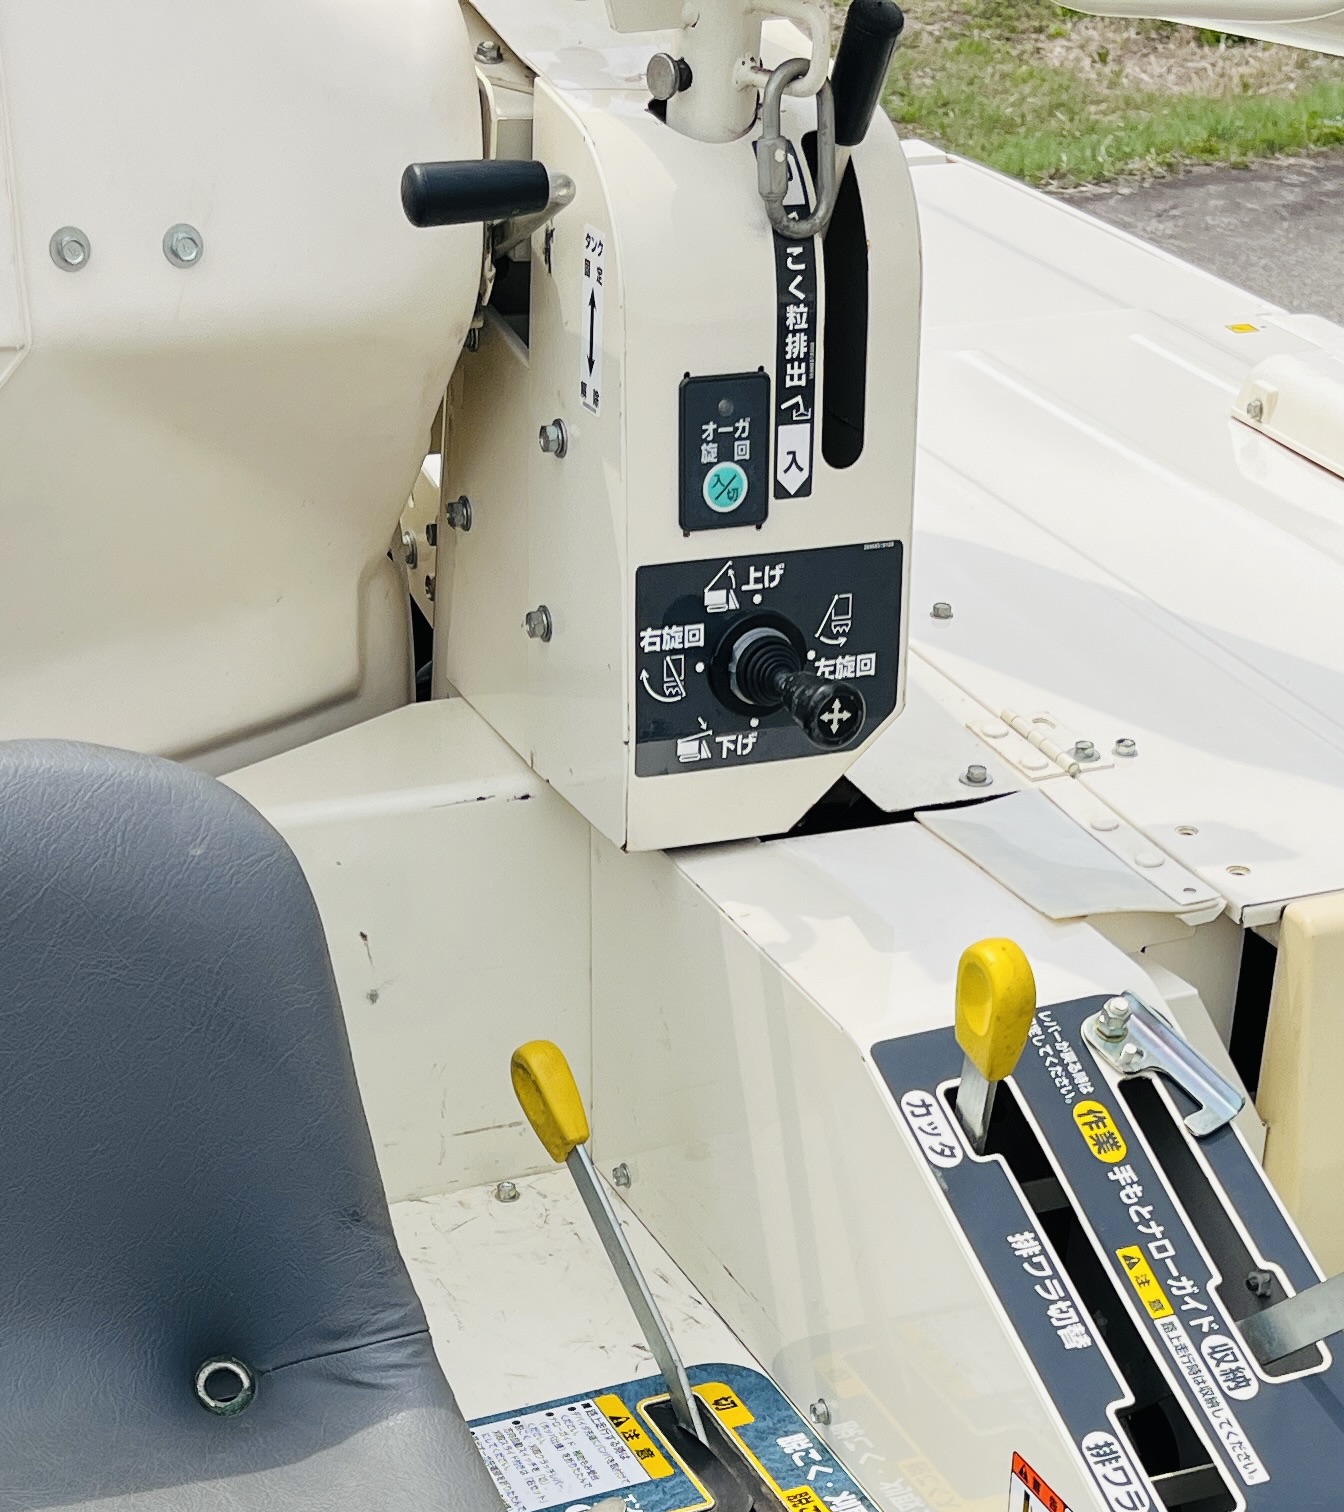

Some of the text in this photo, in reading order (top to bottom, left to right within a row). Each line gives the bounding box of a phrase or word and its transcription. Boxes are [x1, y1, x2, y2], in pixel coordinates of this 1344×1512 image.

[585, 233, 604, 256] タンク
[784, 246, 809, 388] こく粒排出
[701, 417, 751, 441] オーガ
[700, 440, 751, 464] 旋回
[783, 450, 804, 475] 入
[741, 563, 785, 592] 上げ
[639, 623, 705, 653] 右旋回
[814, 652, 877, 680] 左旋回
[715, 732, 758, 759] 下げ
[1028, 1018, 1076, 1104] 定してください。
[906, 1098, 957, 1159] カッタ
[1077, 1109, 1122, 1155] 作業
[1107, 1163, 1220, 1335] 手もとナローガイド
[1007, 1230, 1093, 1350] 排ワラ切替
[1207, 1340, 1253, 1393] 収納
[711, 1395, 739, 1411] 切
[1085, 1440, 1146, 1511] 排ワラ
